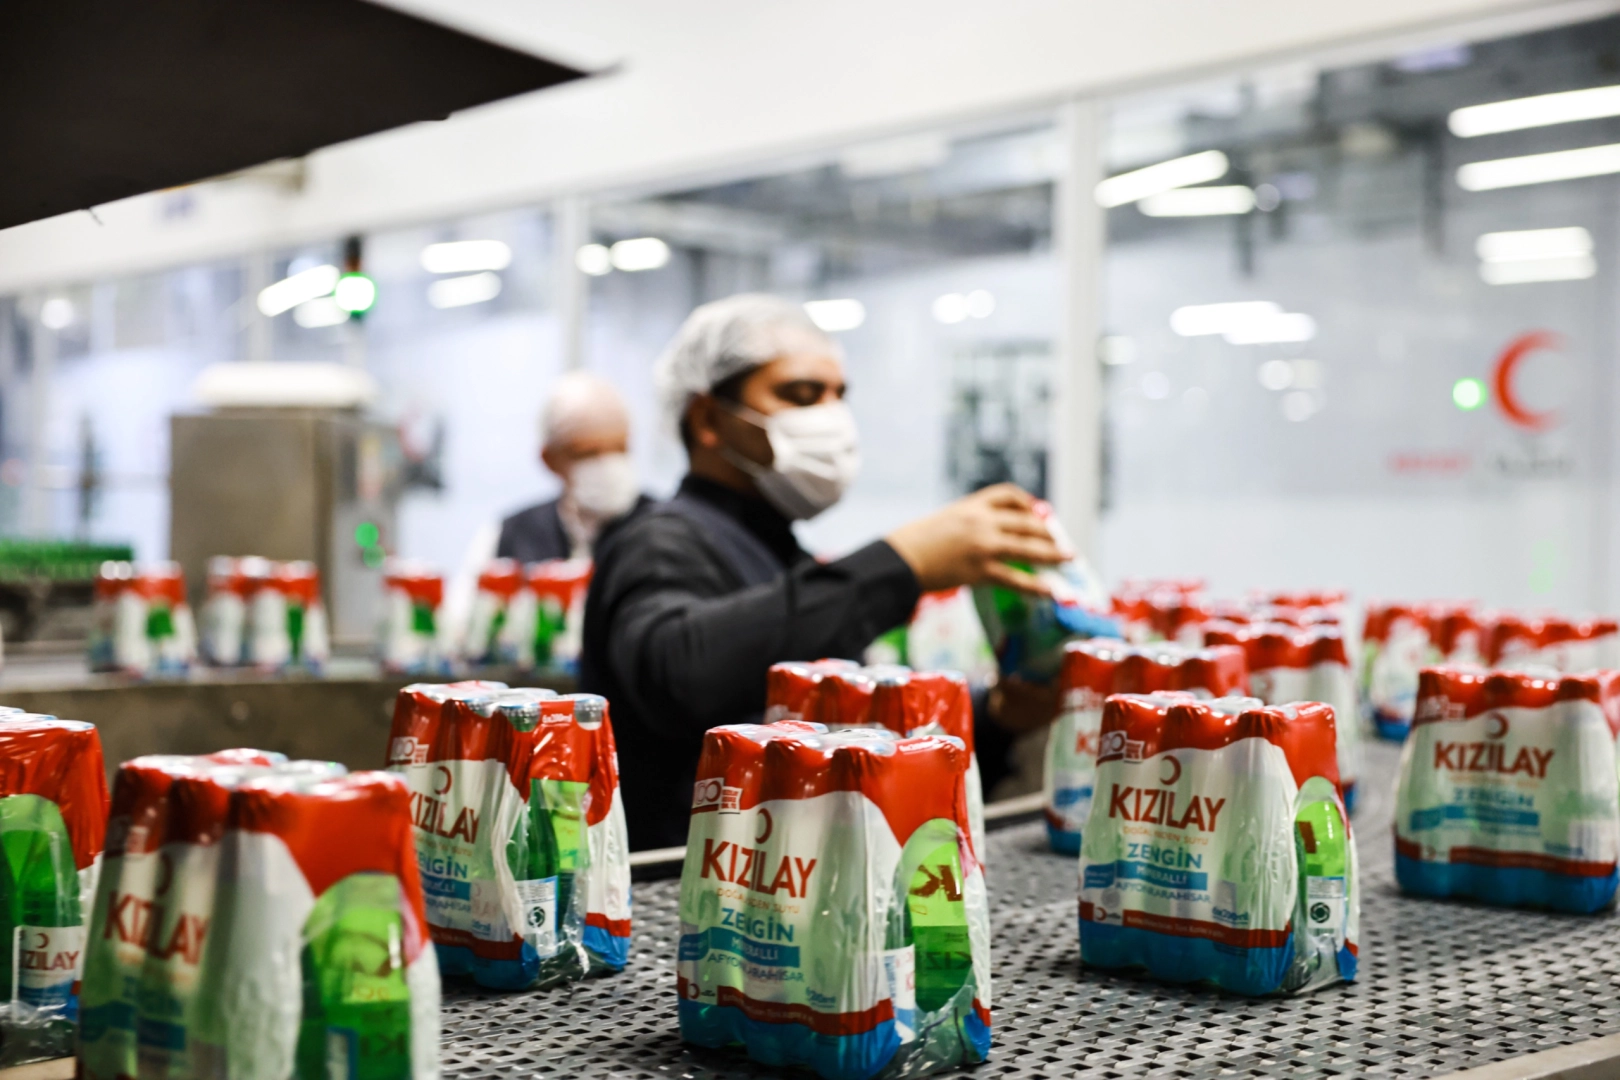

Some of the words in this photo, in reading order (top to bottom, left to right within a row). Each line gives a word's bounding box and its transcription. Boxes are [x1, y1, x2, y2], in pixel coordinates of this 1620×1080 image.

[1433, 740, 1556, 780] KIZILAY
[408, 790, 481, 845] IZILAY
[1108, 783, 1227, 833] KIZILAY
[701, 837, 818, 899] KIZILAY
[1127, 842, 1203, 869] ZENGİN
